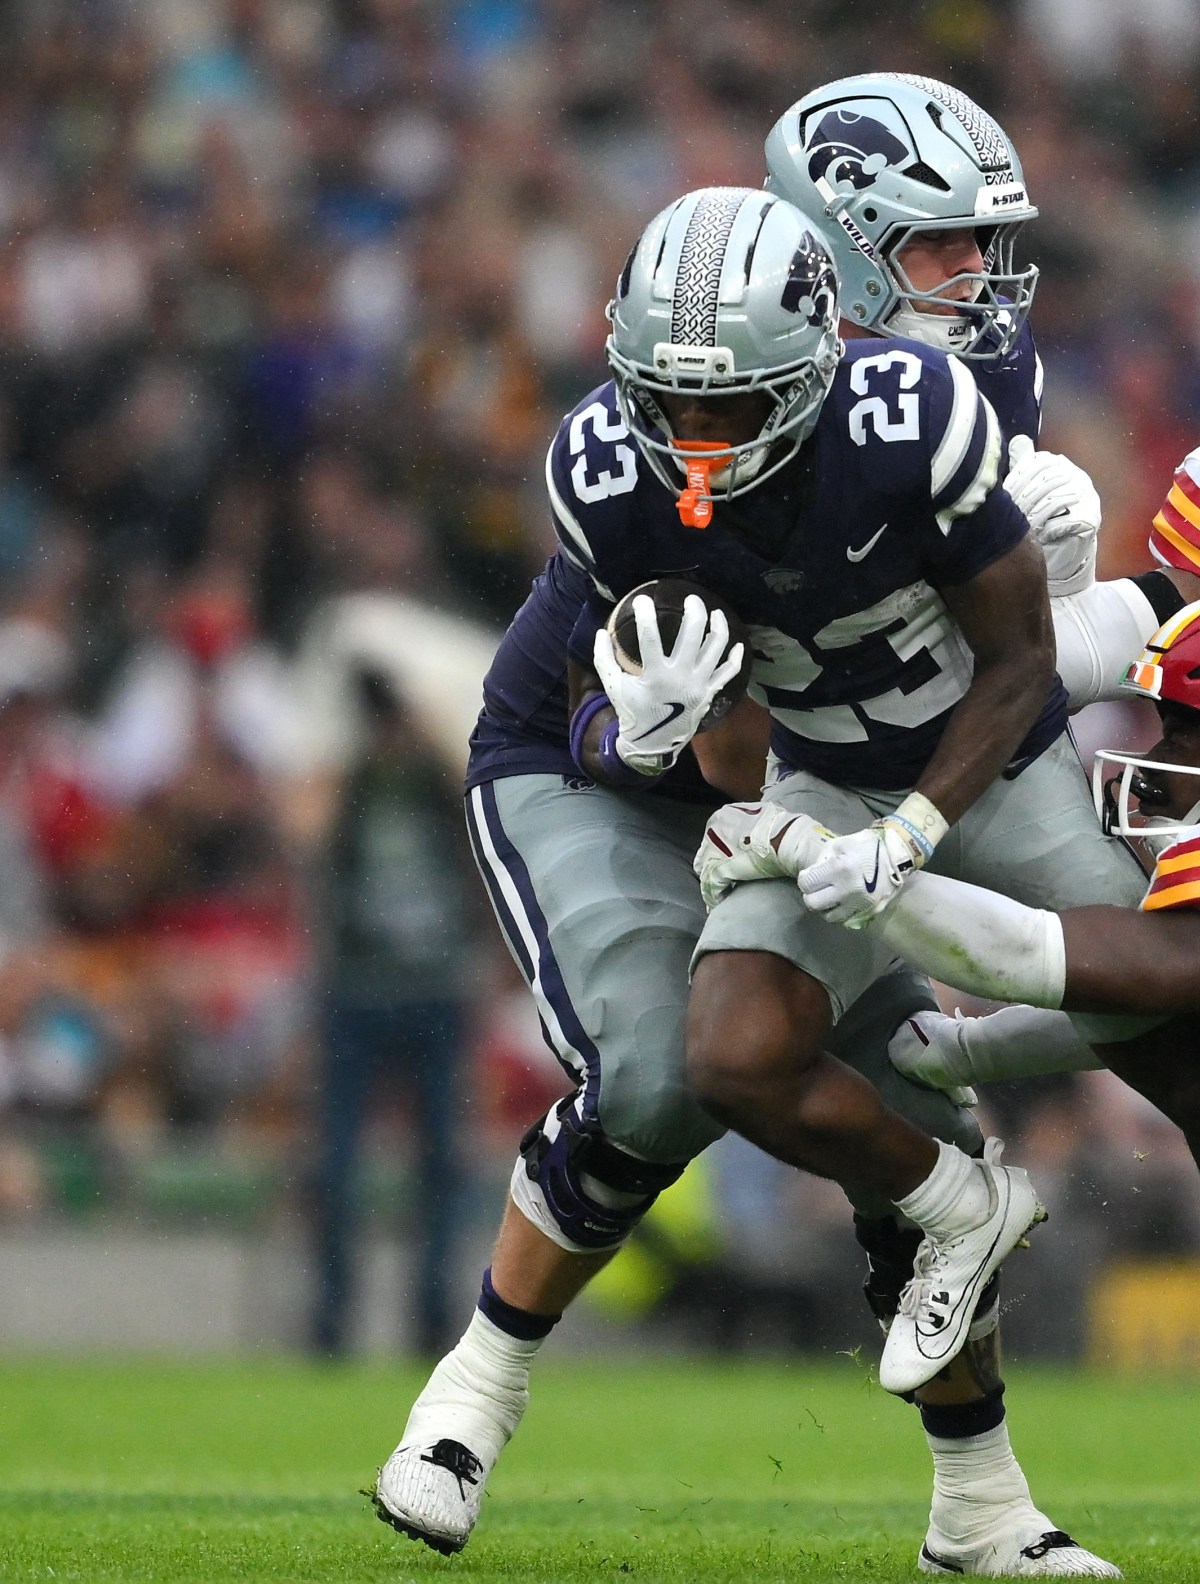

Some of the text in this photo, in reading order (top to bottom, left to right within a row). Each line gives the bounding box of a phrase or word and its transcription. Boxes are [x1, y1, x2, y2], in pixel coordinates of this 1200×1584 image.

[992, 191, 1024, 206] K-STATE
[849, 350, 922, 446] 23
[570, 402, 638, 504] 23
[747, 579, 974, 743] 23
